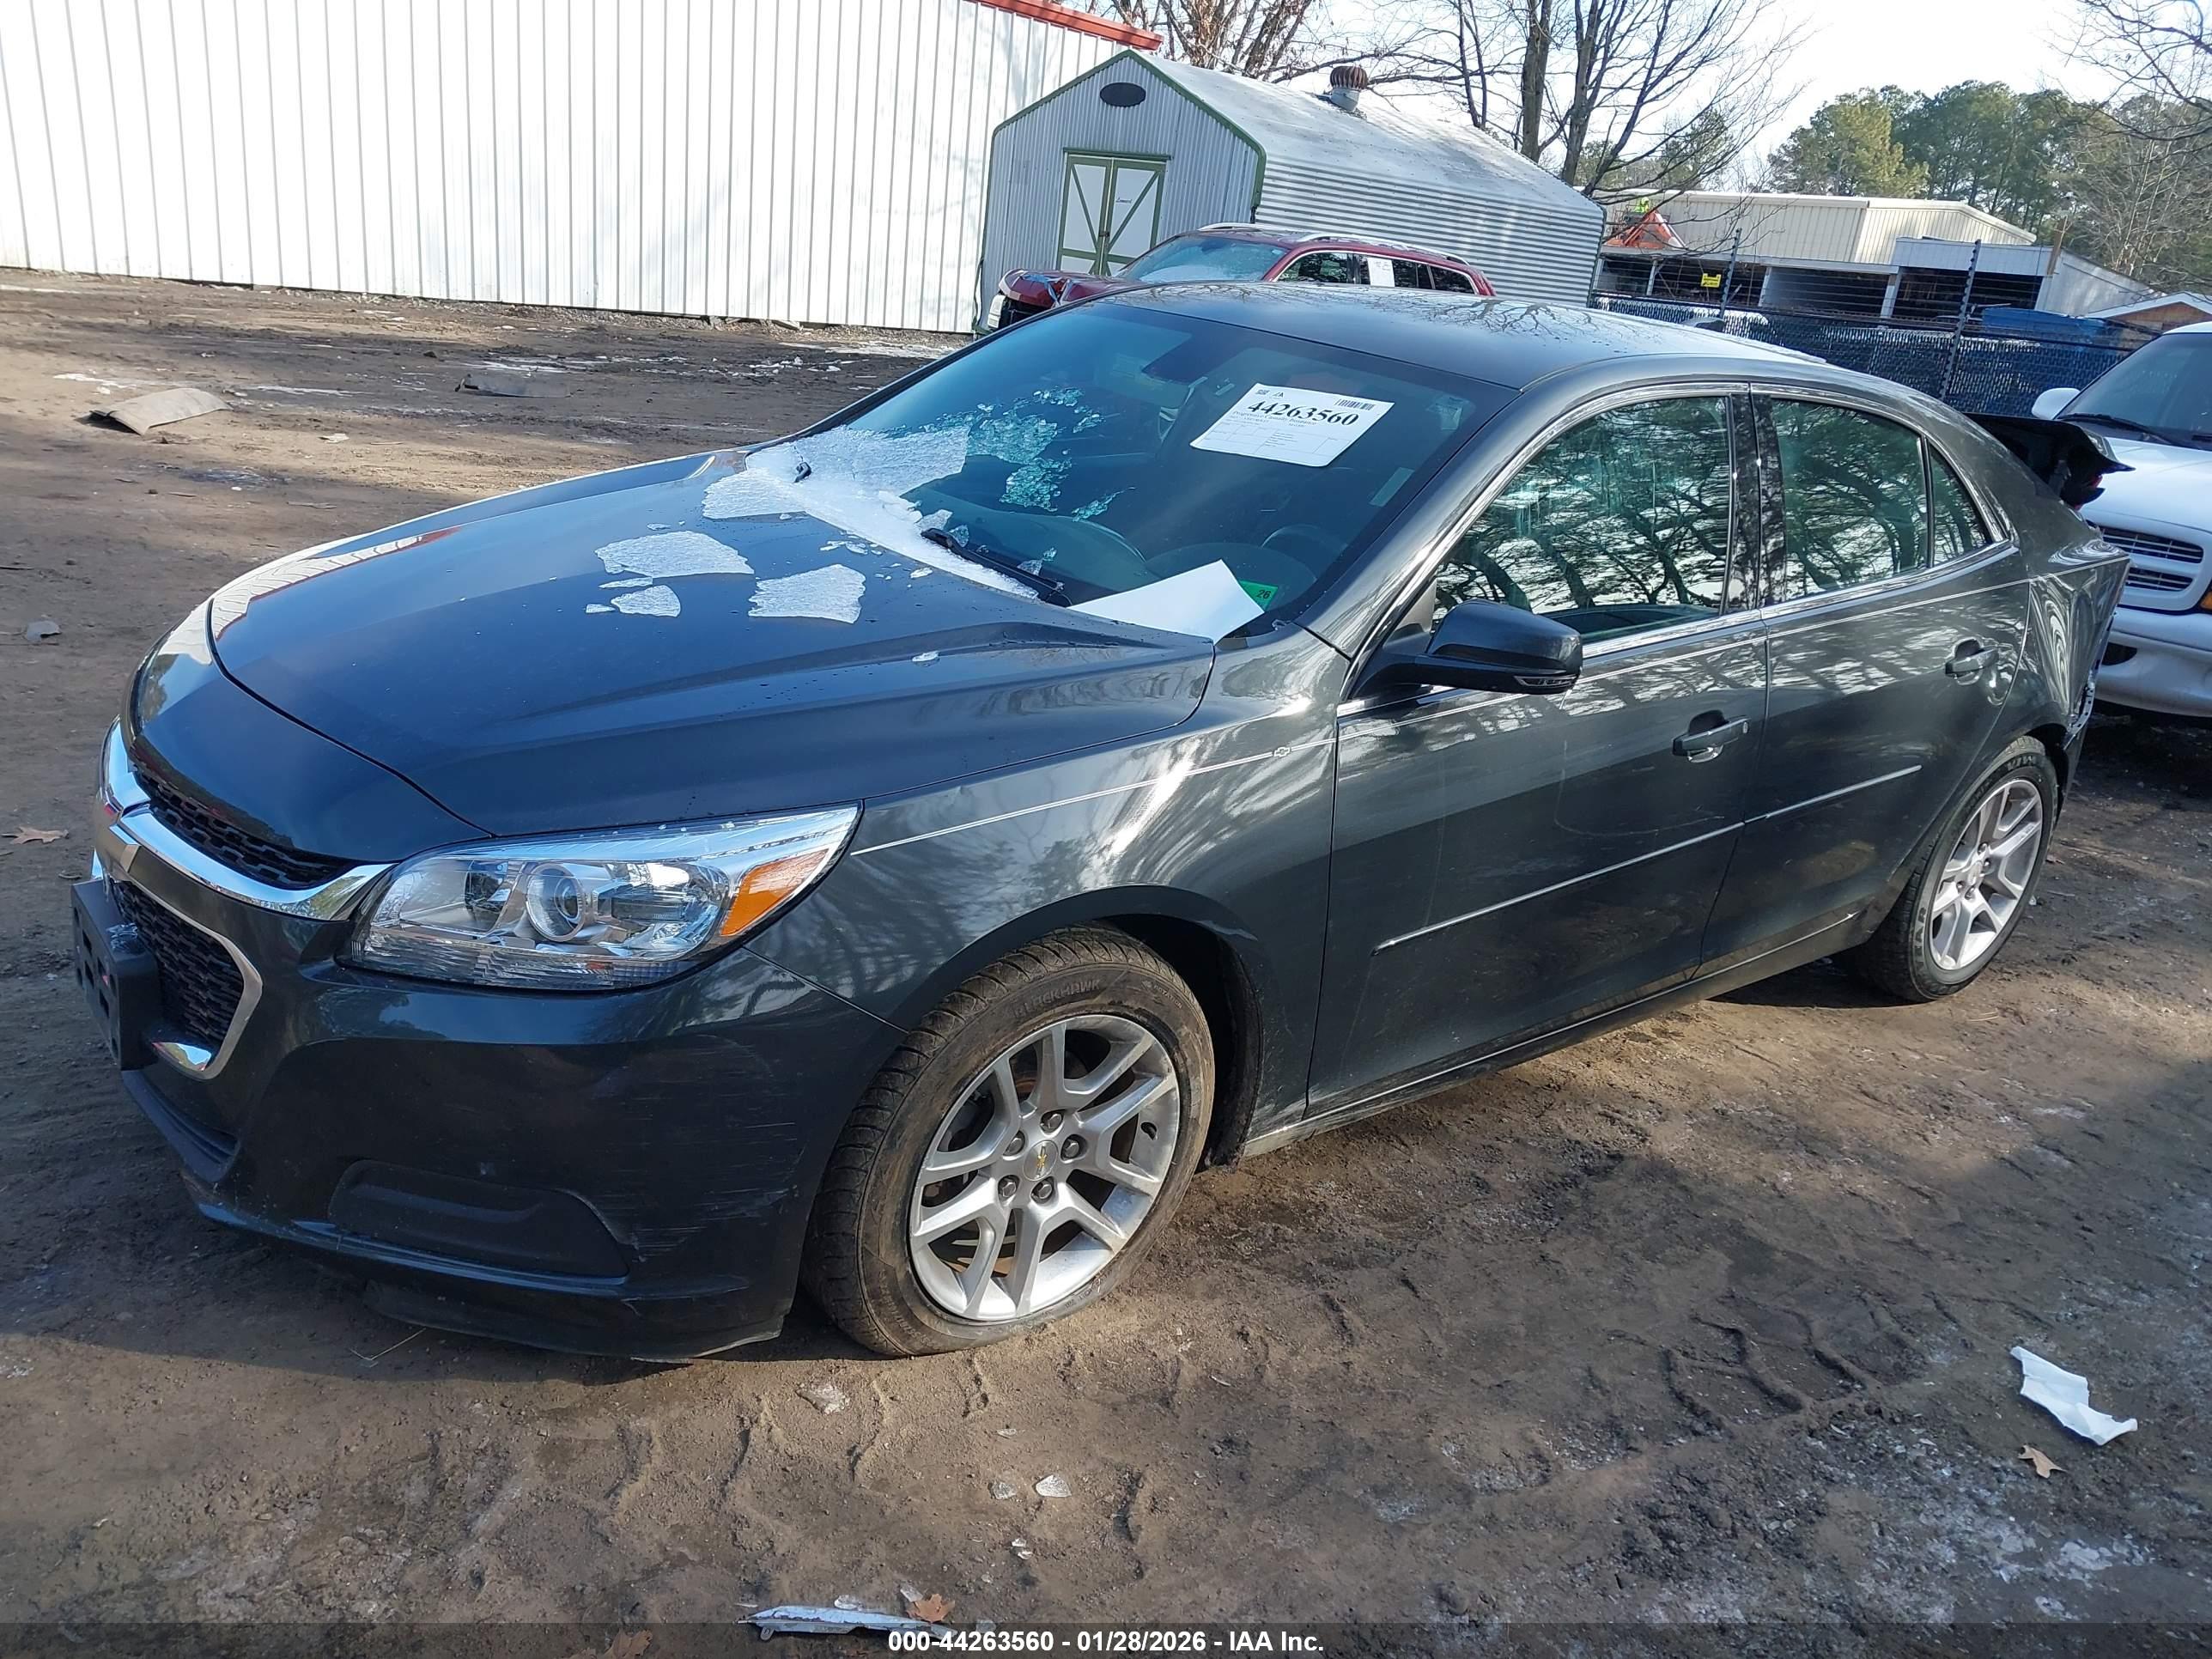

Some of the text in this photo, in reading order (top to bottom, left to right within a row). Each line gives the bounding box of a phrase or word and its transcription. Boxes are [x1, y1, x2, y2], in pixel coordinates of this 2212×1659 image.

[1247, 400, 1359, 426] 44263560
[1256, 589, 1272, 599] 26
[1013, 979, 1102, 1018] BLACKHAWK
